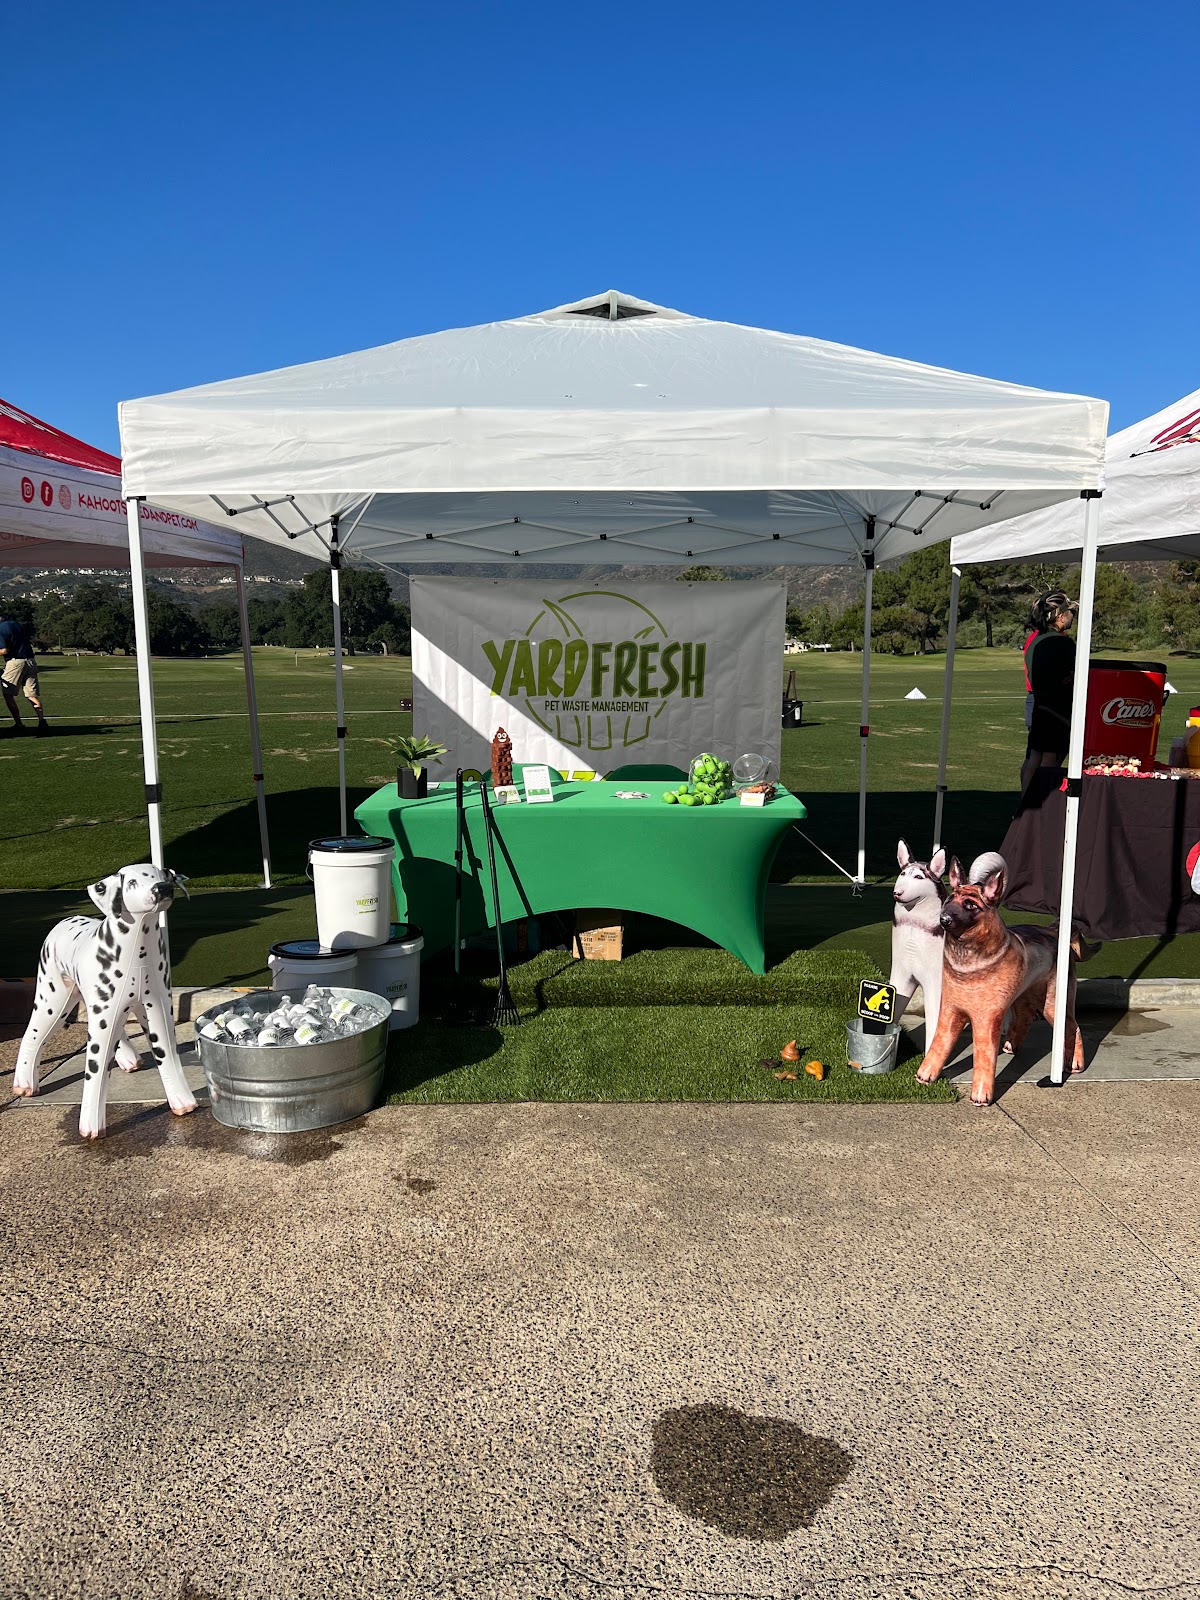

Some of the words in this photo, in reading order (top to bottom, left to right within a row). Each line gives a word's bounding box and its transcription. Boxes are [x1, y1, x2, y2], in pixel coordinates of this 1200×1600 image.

[481, 638, 707, 698] YARDFRESH
[544, 700, 560, 711] PET
[562, 700, 590, 711] WASTE
[591, 701, 650, 712] MANAGEMENT
[1102, 697, 1155, 722] Cane's
